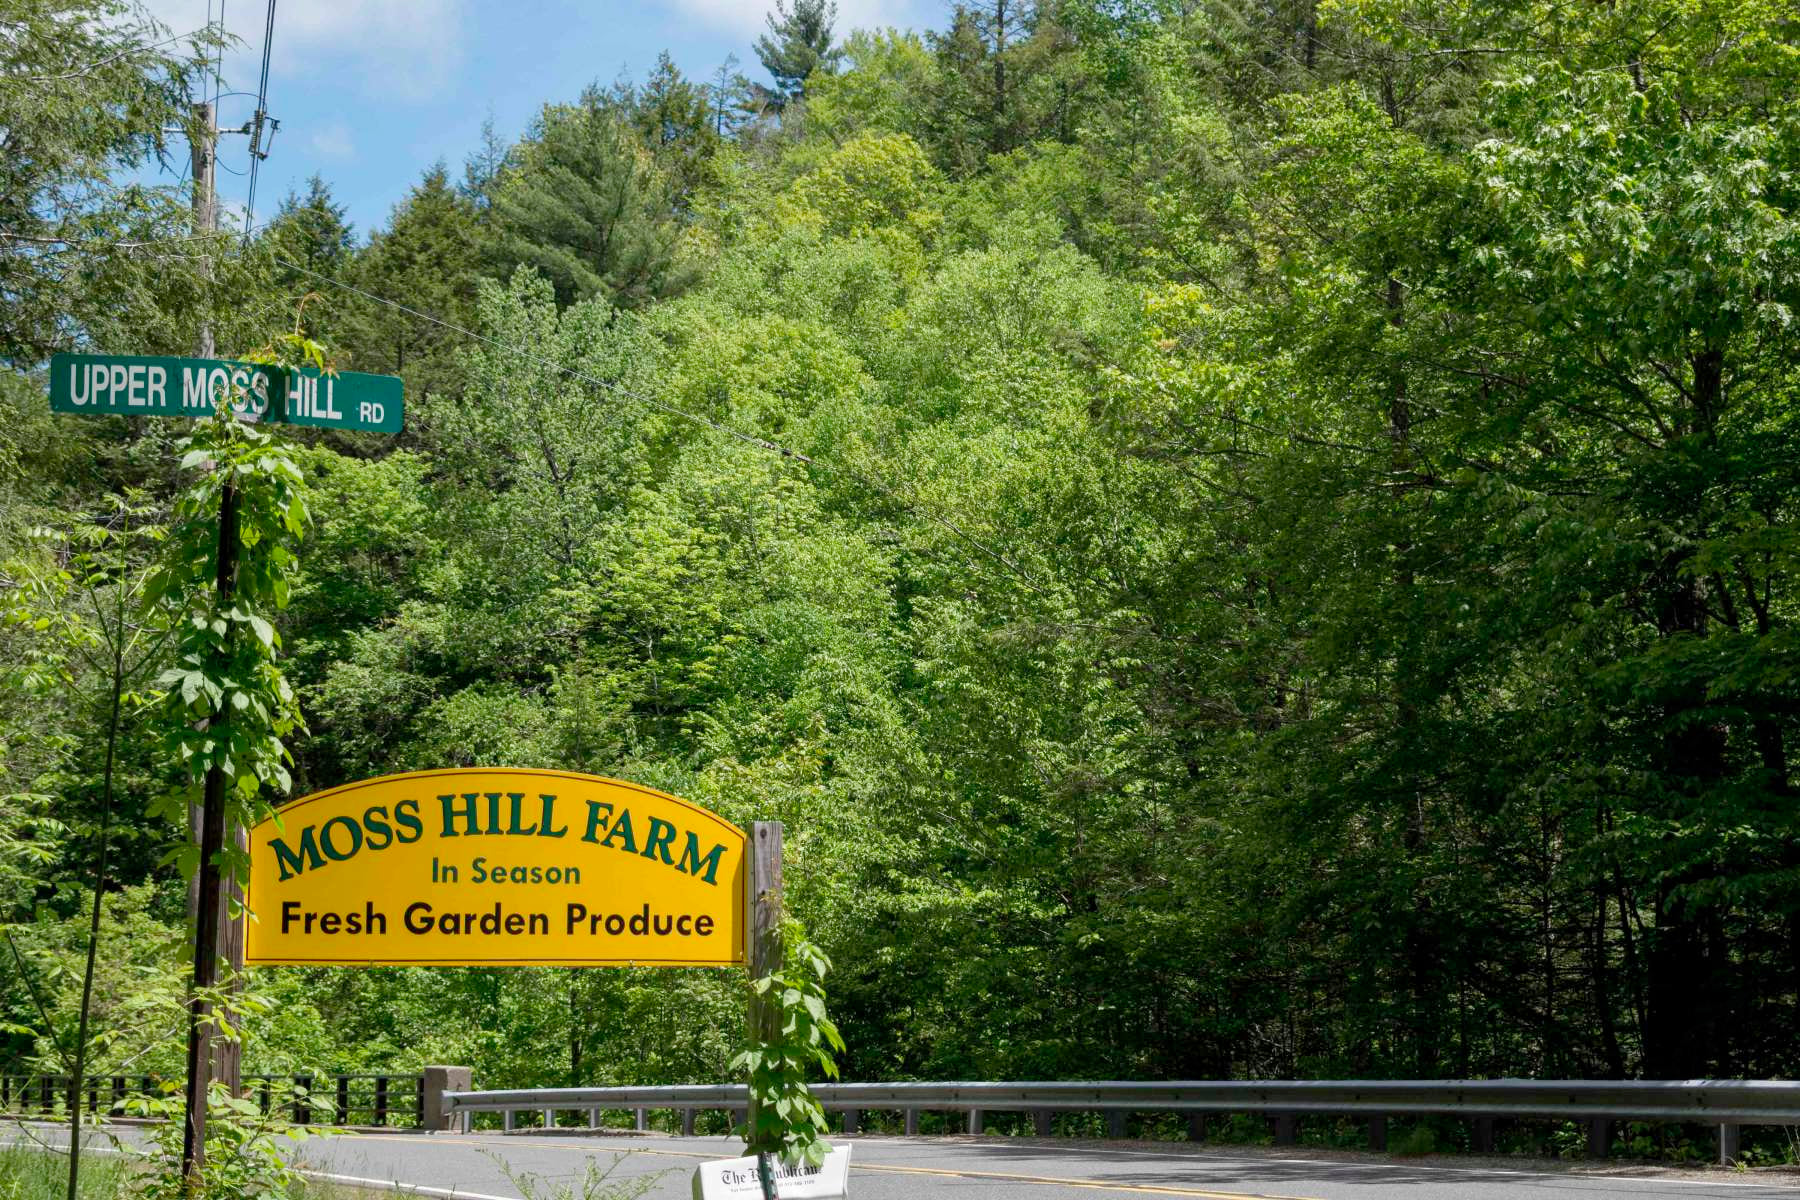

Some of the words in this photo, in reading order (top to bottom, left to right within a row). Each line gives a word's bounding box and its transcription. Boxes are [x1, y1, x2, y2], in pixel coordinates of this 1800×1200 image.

[70, 364, 167, 407] UPPER
[182, 366, 269, 415] MOSS
[285, 373, 343, 420] HILL
[360, 401, 385, 424] RD
[267, 799, 424, 882] MOSS
[437, 792, 568, 837] HILL
[581, 799, 728, 886] FARM
[432, 857, 459, 883] In
[471, 857, 581, 884] Season
[281, 901, 387, 935] Fresh
[404, 901, 549, 936] Garden
[567, 902, 715, 936] Produce
[721, 1169, 746, 1185] The
